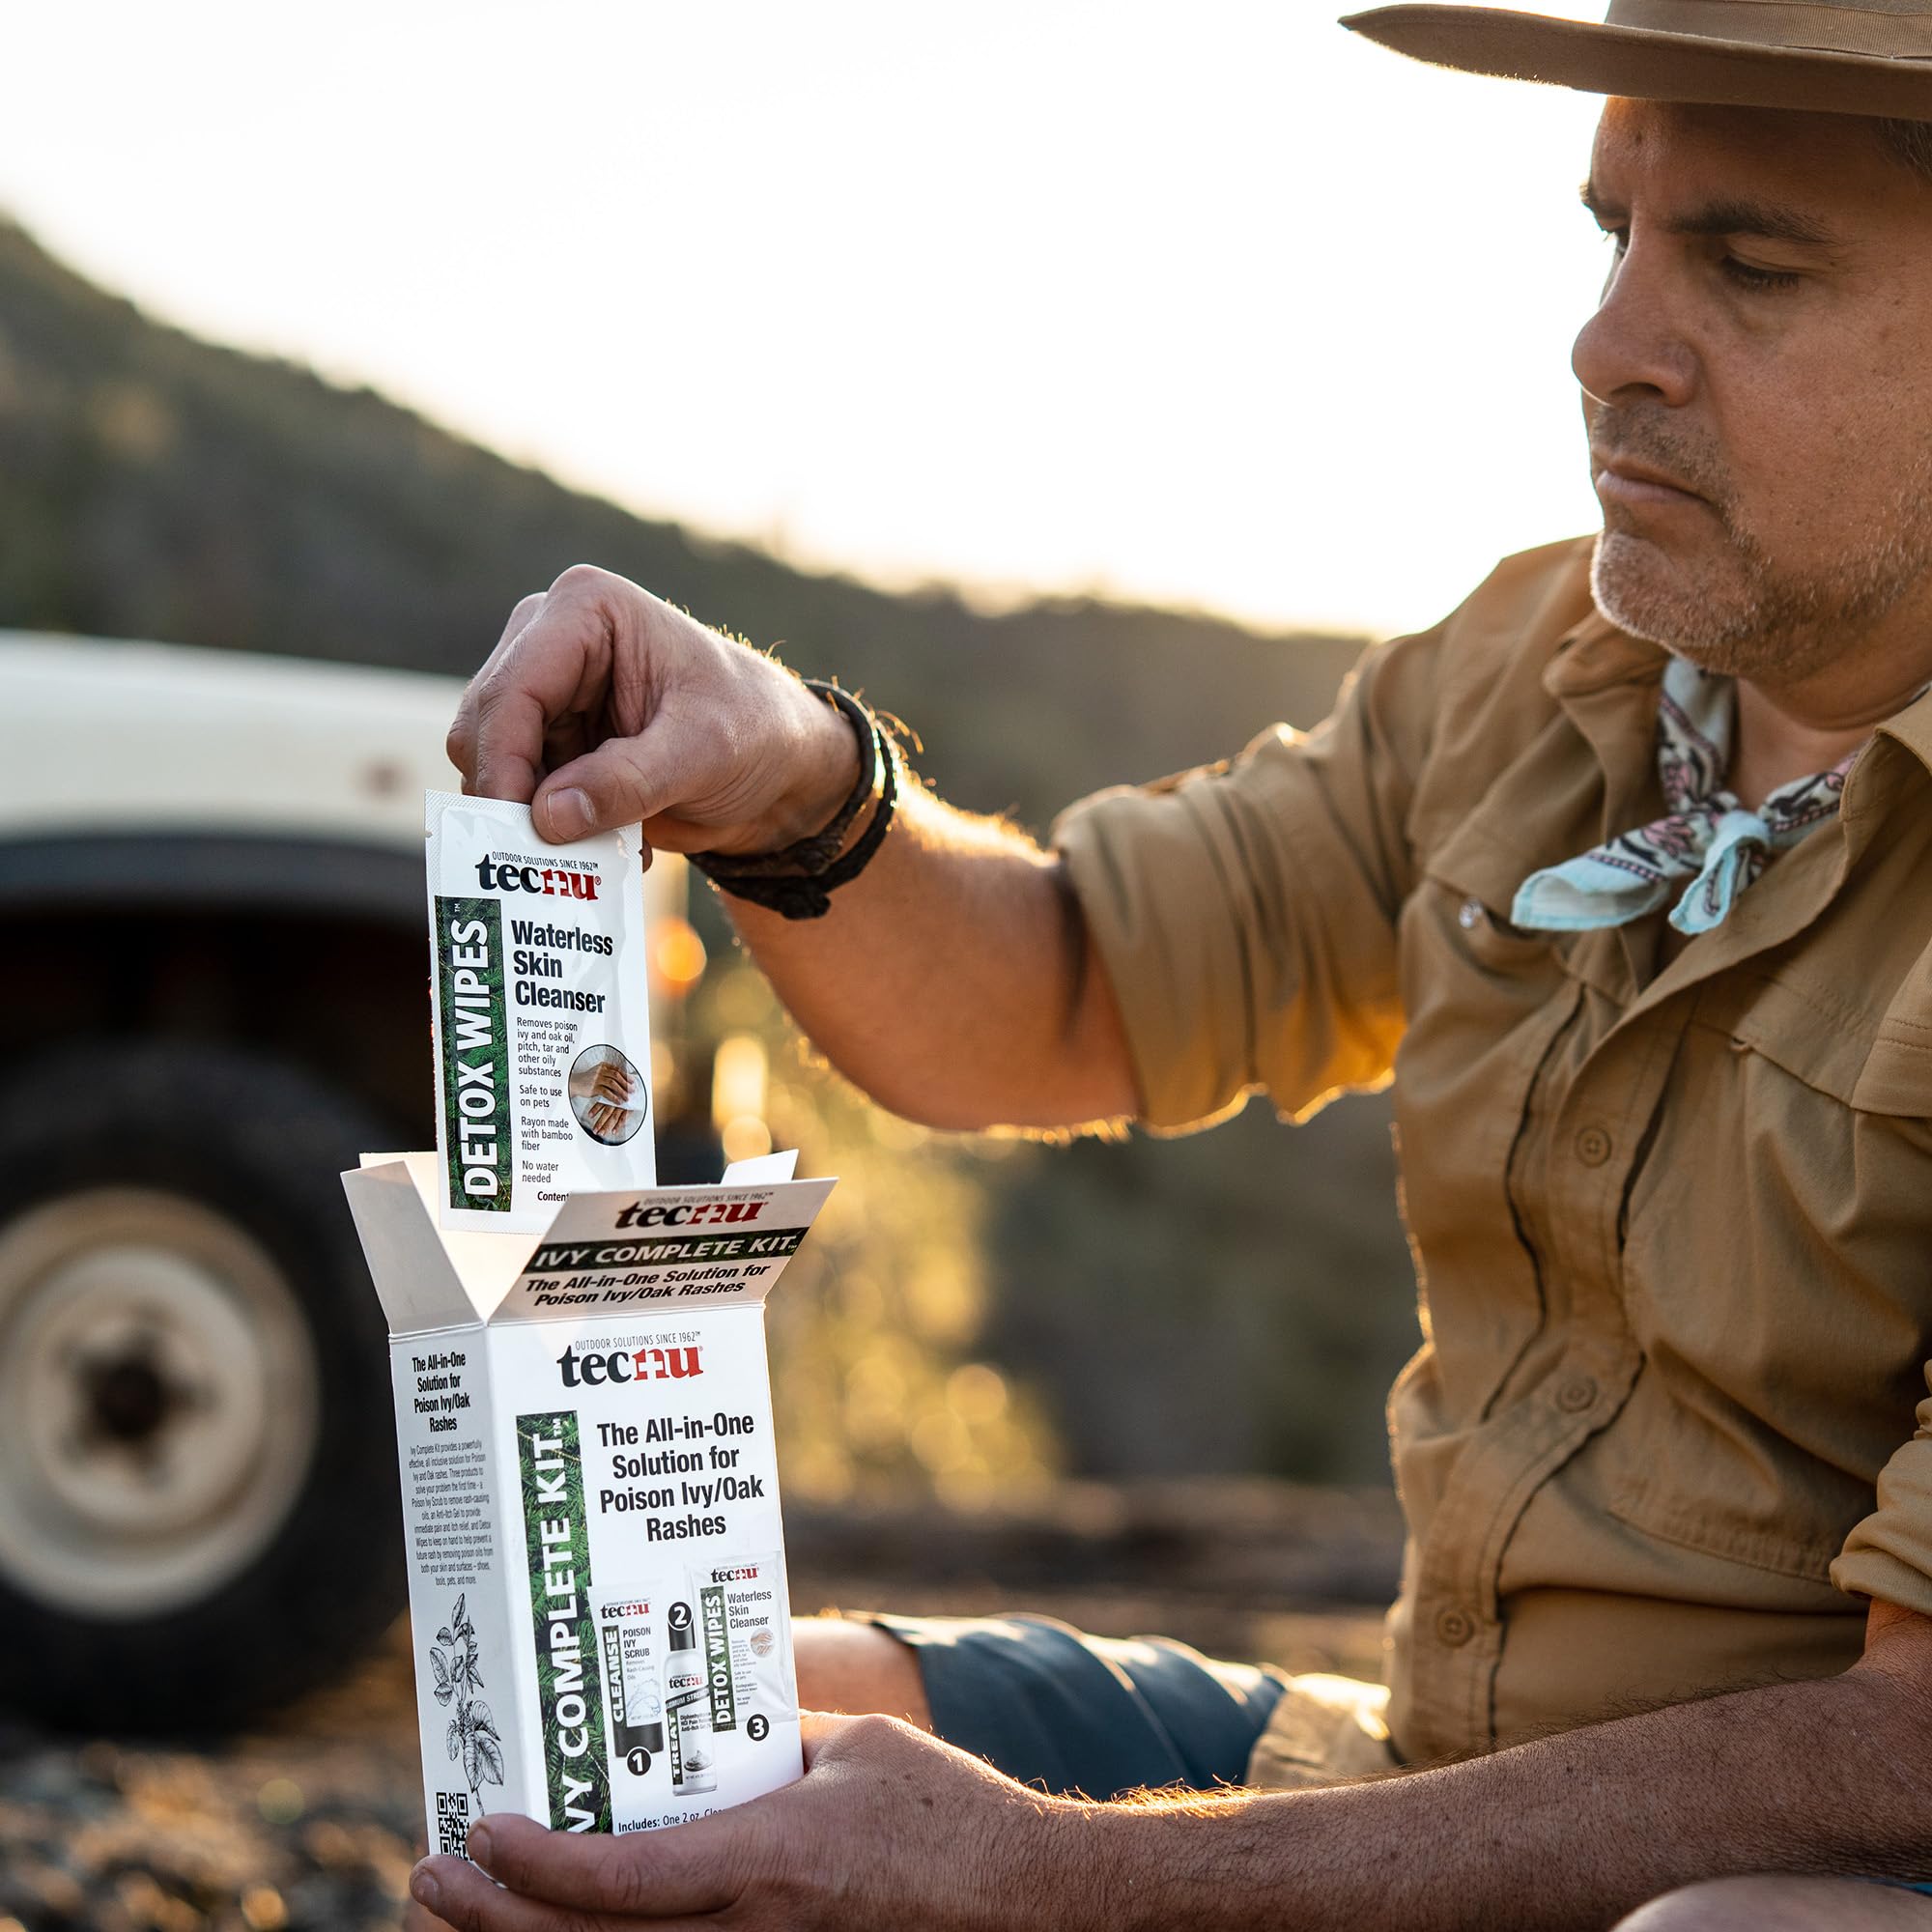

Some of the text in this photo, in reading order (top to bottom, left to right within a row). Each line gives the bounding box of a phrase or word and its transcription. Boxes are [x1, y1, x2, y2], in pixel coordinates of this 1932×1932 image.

[493, 851, 523, 863] OUTDOOR
[524, 856, 557, 867] SOLUTIONS
[559, 860, 578, 869] SINCE
[511, 920, 612, 955] Waterless
[514, 951, 562, 978] Skin
[515, 980, 605, 1012] Cleanser
[517, 1017, 578, 1032] Removes poison
[518, 1029, 575, 1044] ivy and oak oil,
[518, 1042, 569, 1054] pitch, tar and
[518, 1055, 556, 1066] other oily
[519, 1066, 561, 1077] substances
[520, 1085, 562, 1097] Safe to use
[520, 1098, 550, 1109] on pets
[457, 1062, 498, 1196] DETOX
[521, 1117, 569, 1128] Rayon made
[522, 1129, 573, 1141] with bamboo
[522, 1141, 540, 1151] fiber
[523, 1161, 558, 1172] No water
[523, 1173, 551, 1183] needed
[644, 1196, 676, 1206] OUTDOOR
[678, 1194, 724, 1203] SOLUTIONS
[726, 1192, 748, 1201] SINCE
[535, 1249, 590, 1267] IVY
[594, 1238, 745, 1264] COMPLETE
[526, 1263, 771, 1292] The All-in-One Solution for
[534, 1280, 746, 1306] Poison Ivy/Oak Rashes
[576, 1339, 611, 1350] OUTDOOR
[613, 1335, 653, 1349] SOLUTIONS
[656, 1333, 676, 1345] SINCE
[412, 1351, 466, 1373] The All-in-One
[417, 1374, 461, 1393] Solution for
[414, 1393, 470, 1414] Poison Ivy/Oak
[430, 1417, 457, 1433] Rashes
[597, 1412, 753, 1446] The All-in-One
[612, 1445, 740, 1479] Solution for
[600, 1475, 764, 1513] Poison Ivy/Oak
[646, 1515, 725, 1542] Rashes
[727, 1591, 772, 1604] Waterless
[674, 1606, 686, 1625] 2
[729, 1605, 749, 1616] Skin
[623, 1627, 651, 1637] POISON
[730, 1616, 769, 1629] Cleanser
[543, 1518, 588, 1757] COMPLETE
[624, 1639, 636, 1648] IVY
[625, 1648, 649, 1659] SCRUB
[705, 1594, 729, 1724] DETOX WIPES
[605, 1630, 624, 1723] CLEANSE
[753, 1718, 764, 1738] 3
[668, 1714, 681, 1777] TREAT
[633, 1752, 642, 1772] 1
[564, 1775, 596, 1833] VY
[618, 1818, 660, 1833] Includes:
[663, 1815, 679, 1826] One
[683, 1813, 687, 1822] 2
